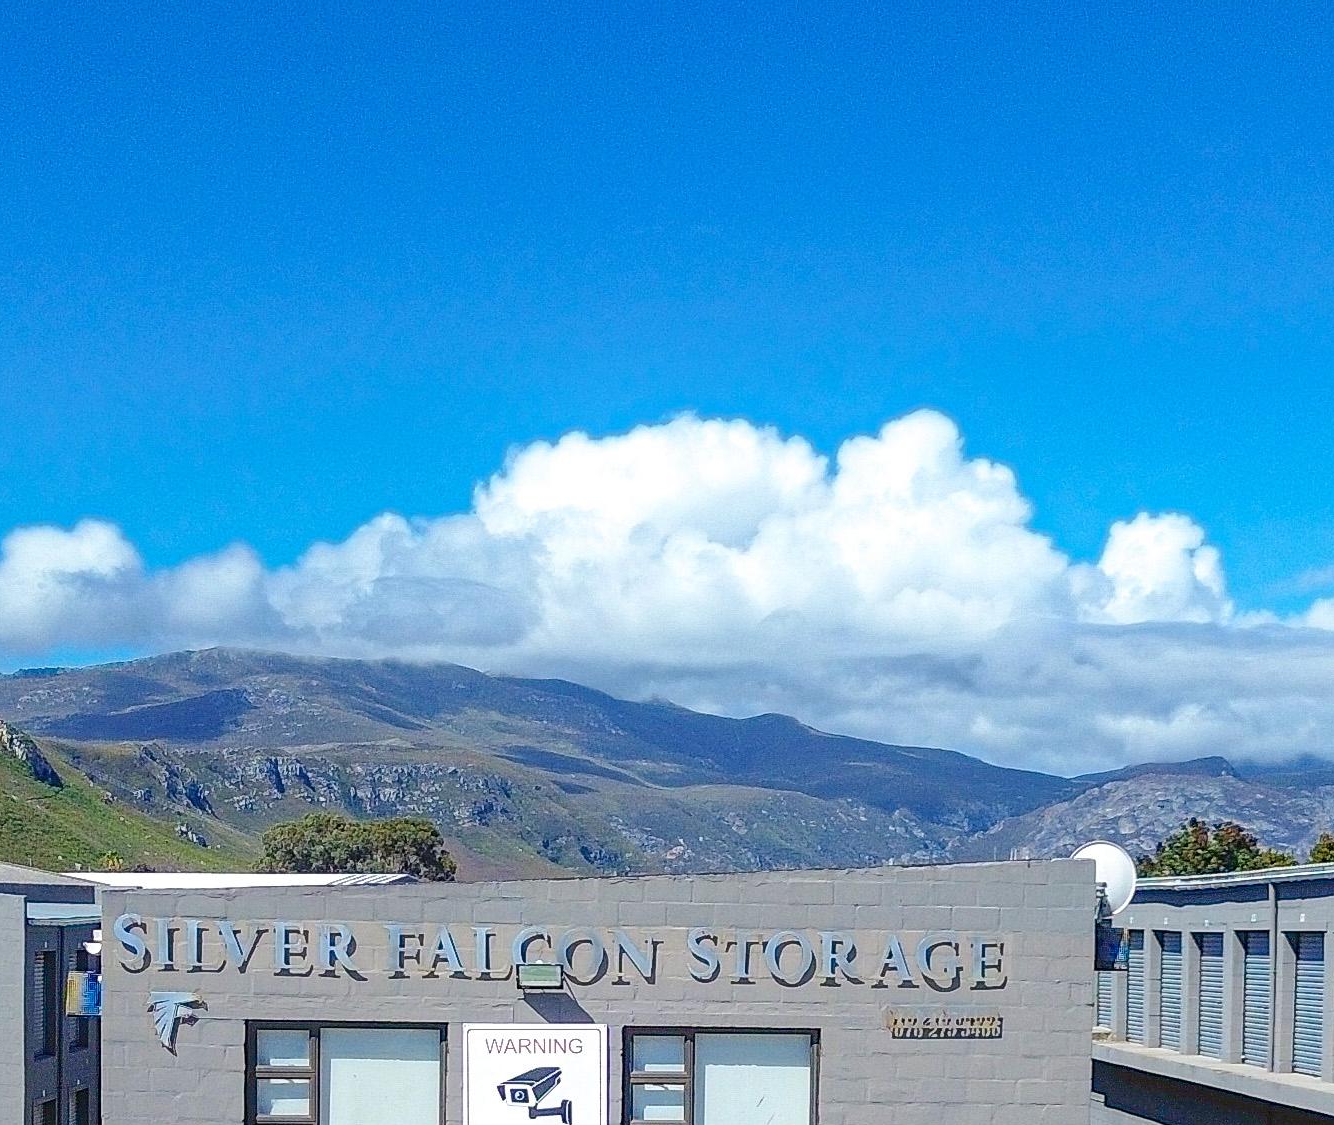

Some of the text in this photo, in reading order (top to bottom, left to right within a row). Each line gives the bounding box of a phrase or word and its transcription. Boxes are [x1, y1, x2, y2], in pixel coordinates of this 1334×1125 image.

[113, 913, 1006, 988] SILVER FALCON STORAGE
[485, 1038, 583, 1054] WARNING
